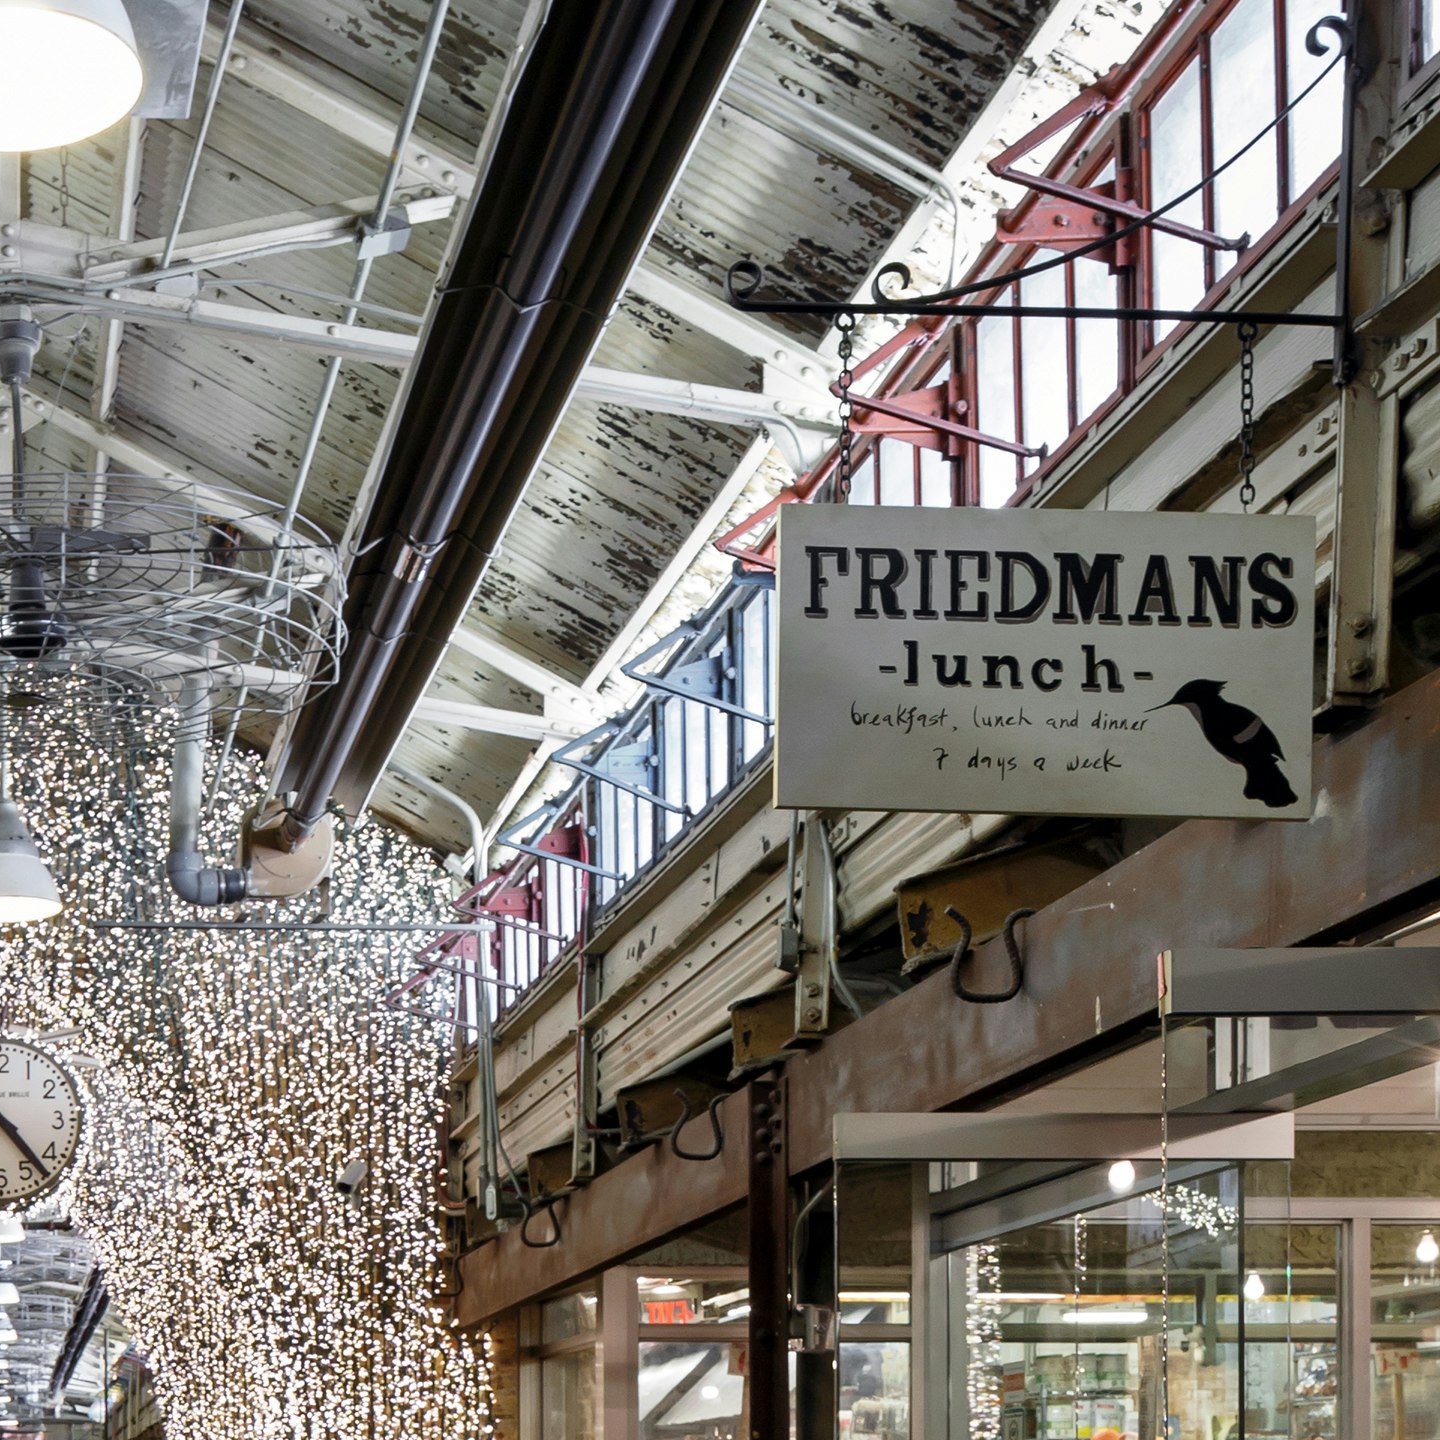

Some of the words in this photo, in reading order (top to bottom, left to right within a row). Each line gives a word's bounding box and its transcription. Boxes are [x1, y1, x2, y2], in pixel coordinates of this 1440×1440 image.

[804, 545, 1298, 629] FRIEDMANS
[973, 705, 1032, 727] lunch
[1046, 709, 1079, 729] and
[1091, 710, 1149, 732] dinner
[933, 747, 949, 771] 7
[967, 747, 1017, 782] days
[1034, 757, 1045, 771] a
[1066, 748, 1122, 773] week
[43, 1079, 56, 1099] 2
[52, 1110, 64, 1130] 3
[42, 1141, 57, 1160] 4
[19, 1161, 33, 1180] 5
